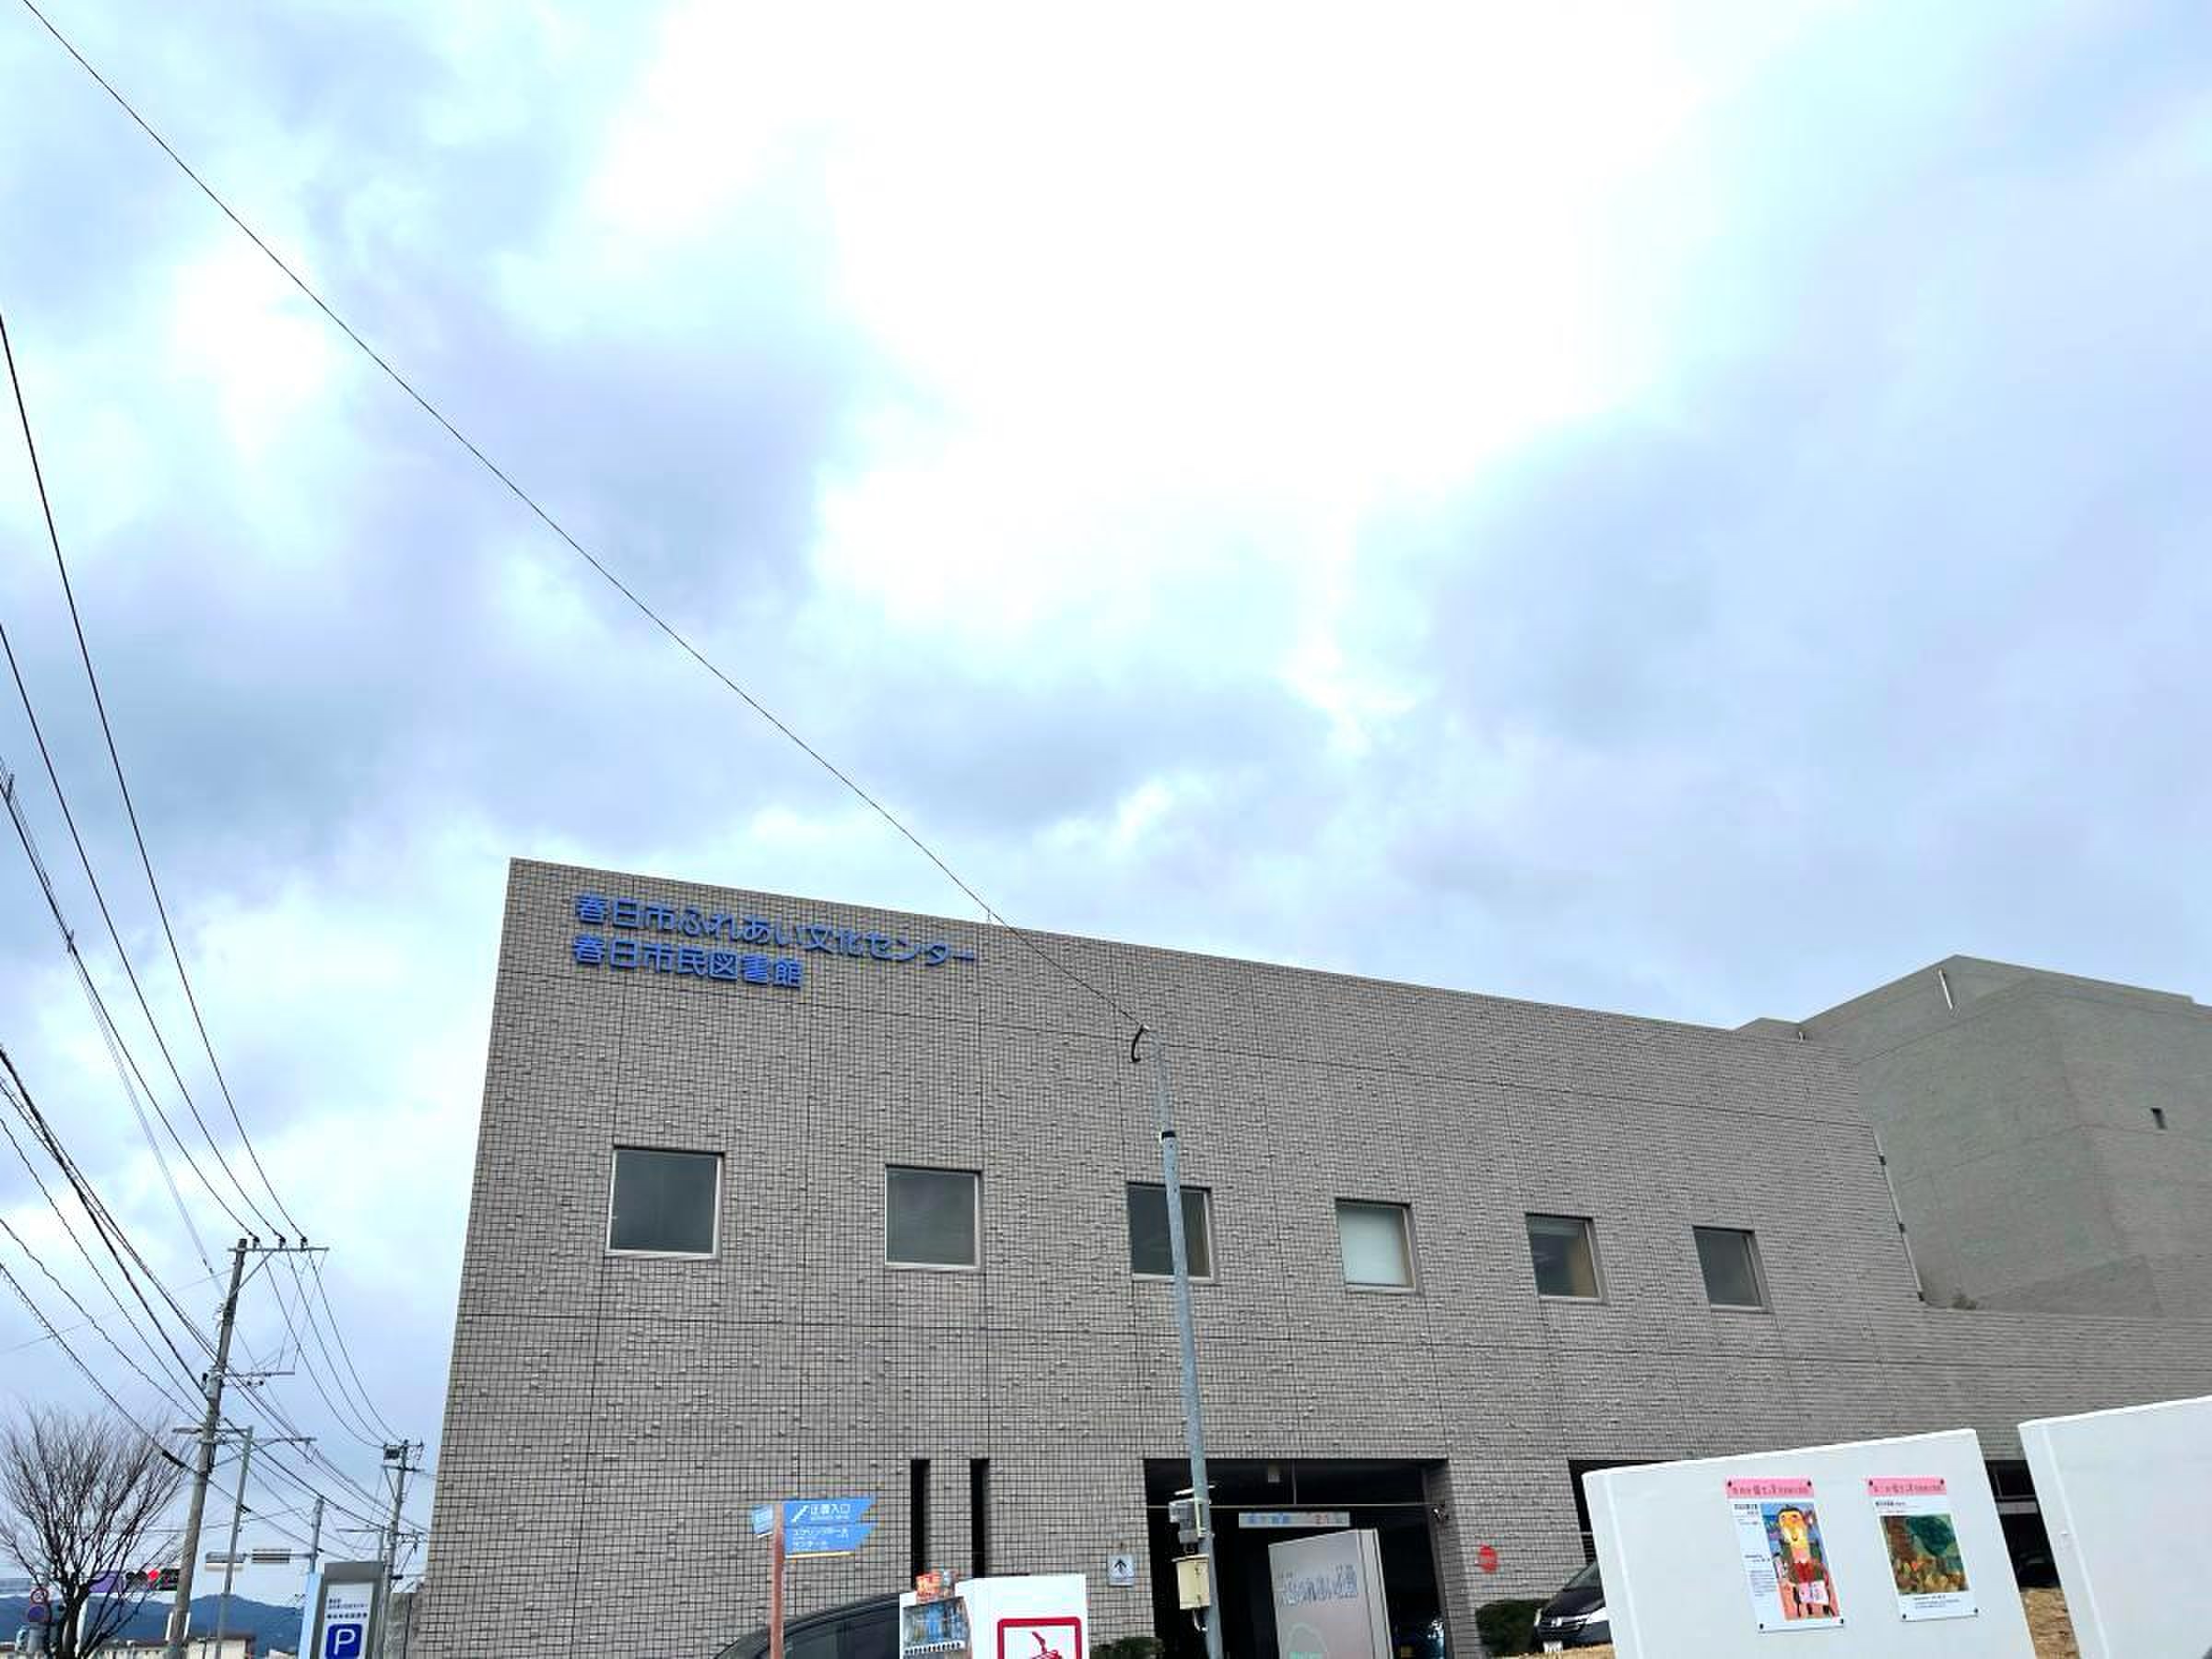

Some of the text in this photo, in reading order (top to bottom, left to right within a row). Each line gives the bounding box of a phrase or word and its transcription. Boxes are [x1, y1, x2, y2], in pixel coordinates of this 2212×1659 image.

[576, 892, 975, 966] 春日市ふれあい文化センター
[574, 934, 803, 989] 春日市民図書館
[811, 1503, 851, 1515] 入口
[333, 1628, 356, 1656] P
